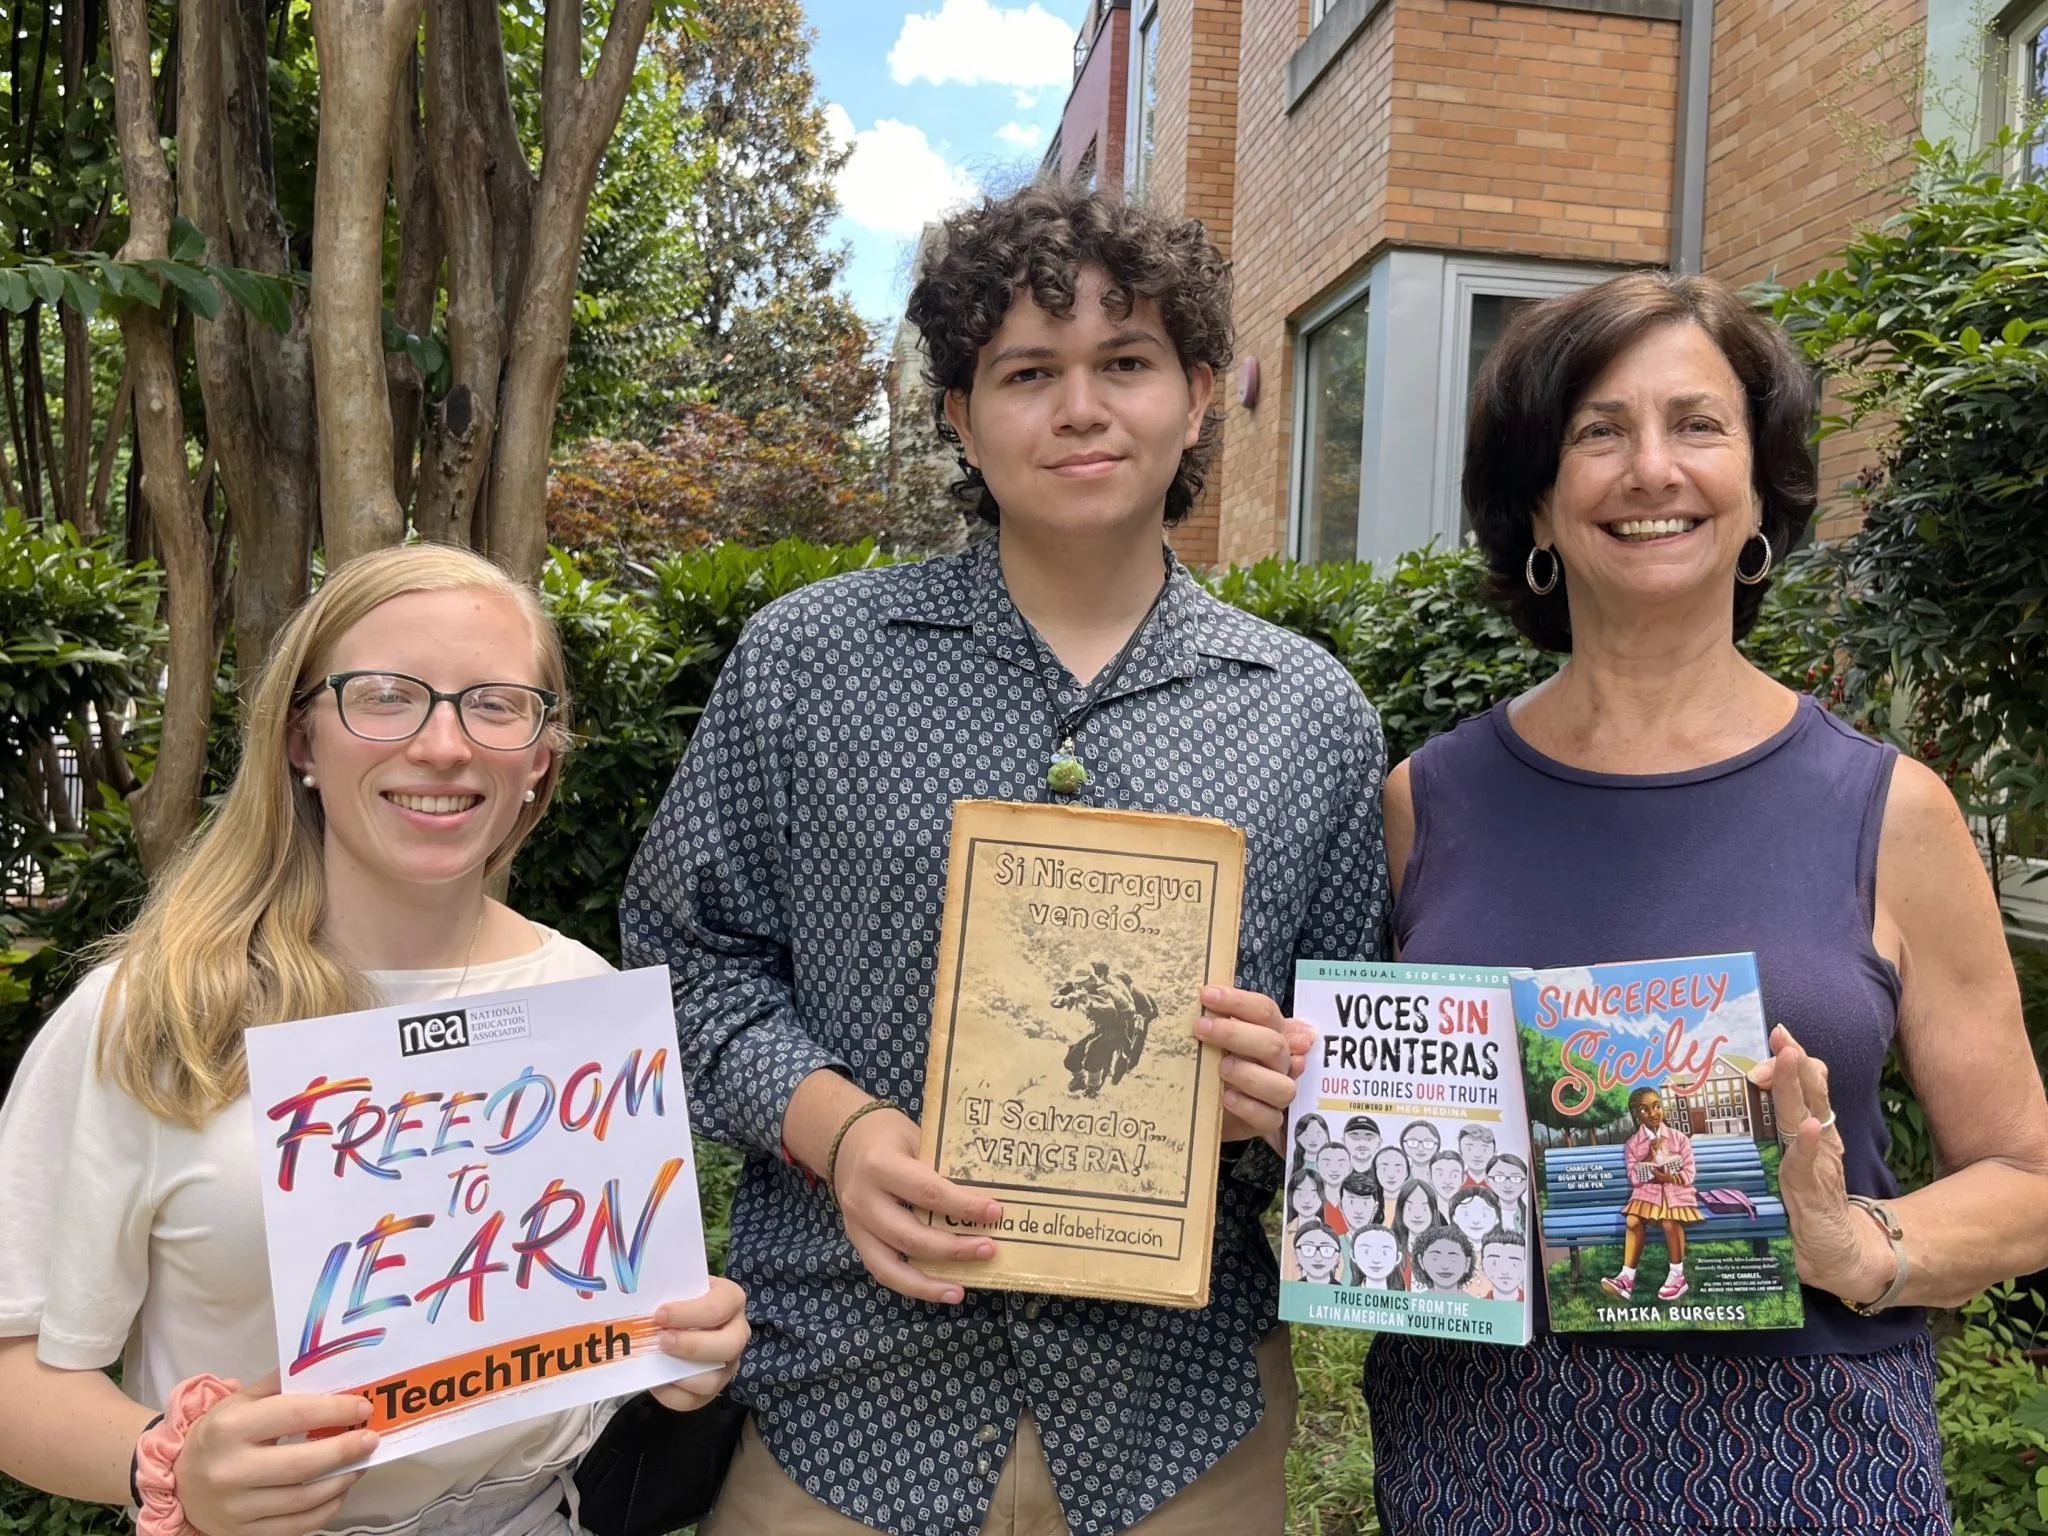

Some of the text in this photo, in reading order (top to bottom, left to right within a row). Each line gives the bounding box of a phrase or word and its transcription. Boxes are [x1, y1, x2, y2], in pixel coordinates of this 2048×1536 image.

[1032, 857, 1202, 910] Nicaragua
[1319, 967, 1510, 985] BILINGUAL SIDE-BY-SIDE
[470, 1006, 525, 1021] NATIONAL
[1335, 993, 1489, 1036] VOCES SIN
[1535, 971, 1729, 1029] SINCERELY
[403, 1015, 466, 1052] nea
[471, 1016, 526, 1031] EDUCATION
[472, 1025, 527, 1041] ASSOCIATION
[1323, 1035, 1499, 1081] FRONTERAS
[1551, 1015, 1729, 1116] Sicily
[1321, 1077, 1498, 1105] OUR STORIES OUR TRUTH
[1349, 1101, 1468, 1118] FOREWORD BY MEG MEDINA
[266, 1048, 668, 1192] FREEDOM
[964, 1096, 991, 1126] El
[975, 1137, 1146, 1177] VENCERA!
[447, 1162, 490, 1218] TO
[1019, 1209, 1039, 1233] de
[1043, 1212, 1163, 1248] alfabetización
[288, 1157, 685, 1377] LEARN
[1309, 1305, 1493, 1335] LATIN AMERICAN YOUTH CENTER
[1334, 1291, 1469, 1317] TRUE COMICS FROM THE
[1597, 1305, 1745, 1322] TAMIKA BURGESS
